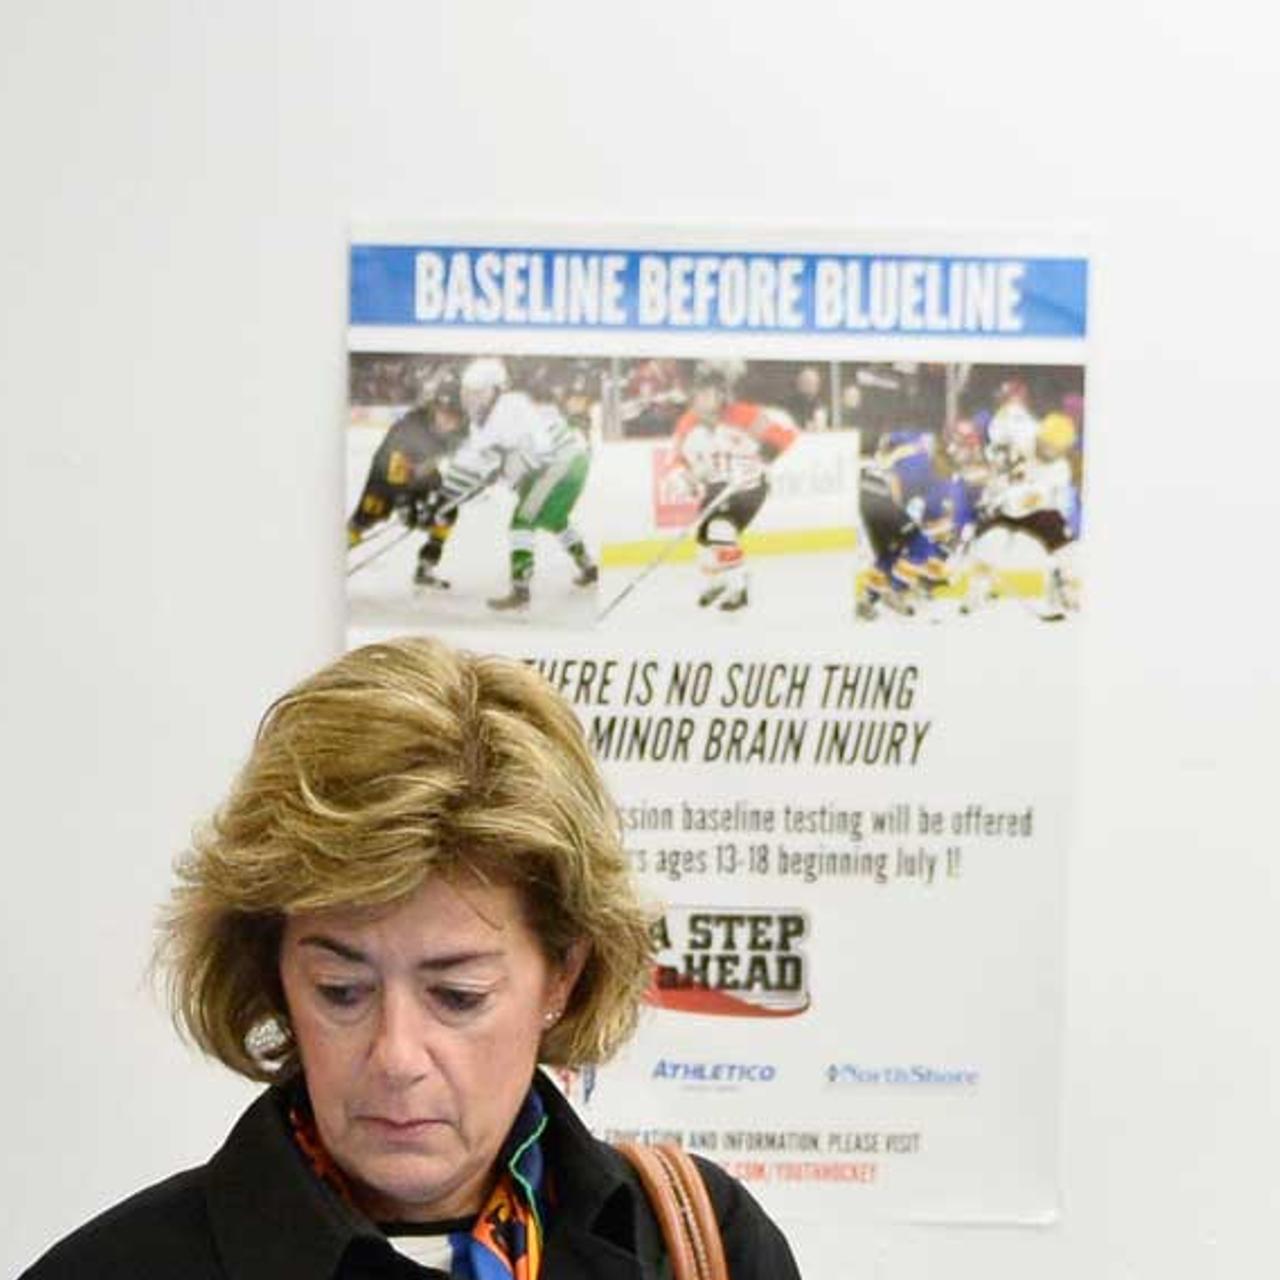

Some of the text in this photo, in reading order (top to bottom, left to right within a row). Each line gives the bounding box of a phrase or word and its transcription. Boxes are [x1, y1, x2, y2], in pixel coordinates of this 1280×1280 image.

[414, 251, 1026, 332] BASELINE BEFORE BLUELINE
[623, 661, 659, 707] IS
[667, 661, 714, 708] NO
[721, 662, 811, 709] SUCH
[819, 664, 920, 711] THING
[588, 716, 931, 766] MINOR BRAIN INJURY
[681, 801, 775, 832] baseline
[784, 803, 863, 842] testing
[872, 803, 910, 835] will
[919, 804, 943, 835] be
[950, 803, 1034, 837] offered
[655, 849, 707, 881] ages
[716, 843, 769, 875] 13-18
[777, 845, 888, 884] beginning
[895, 846, 937, 884] July
[689, 914, 806, 951] STEP
